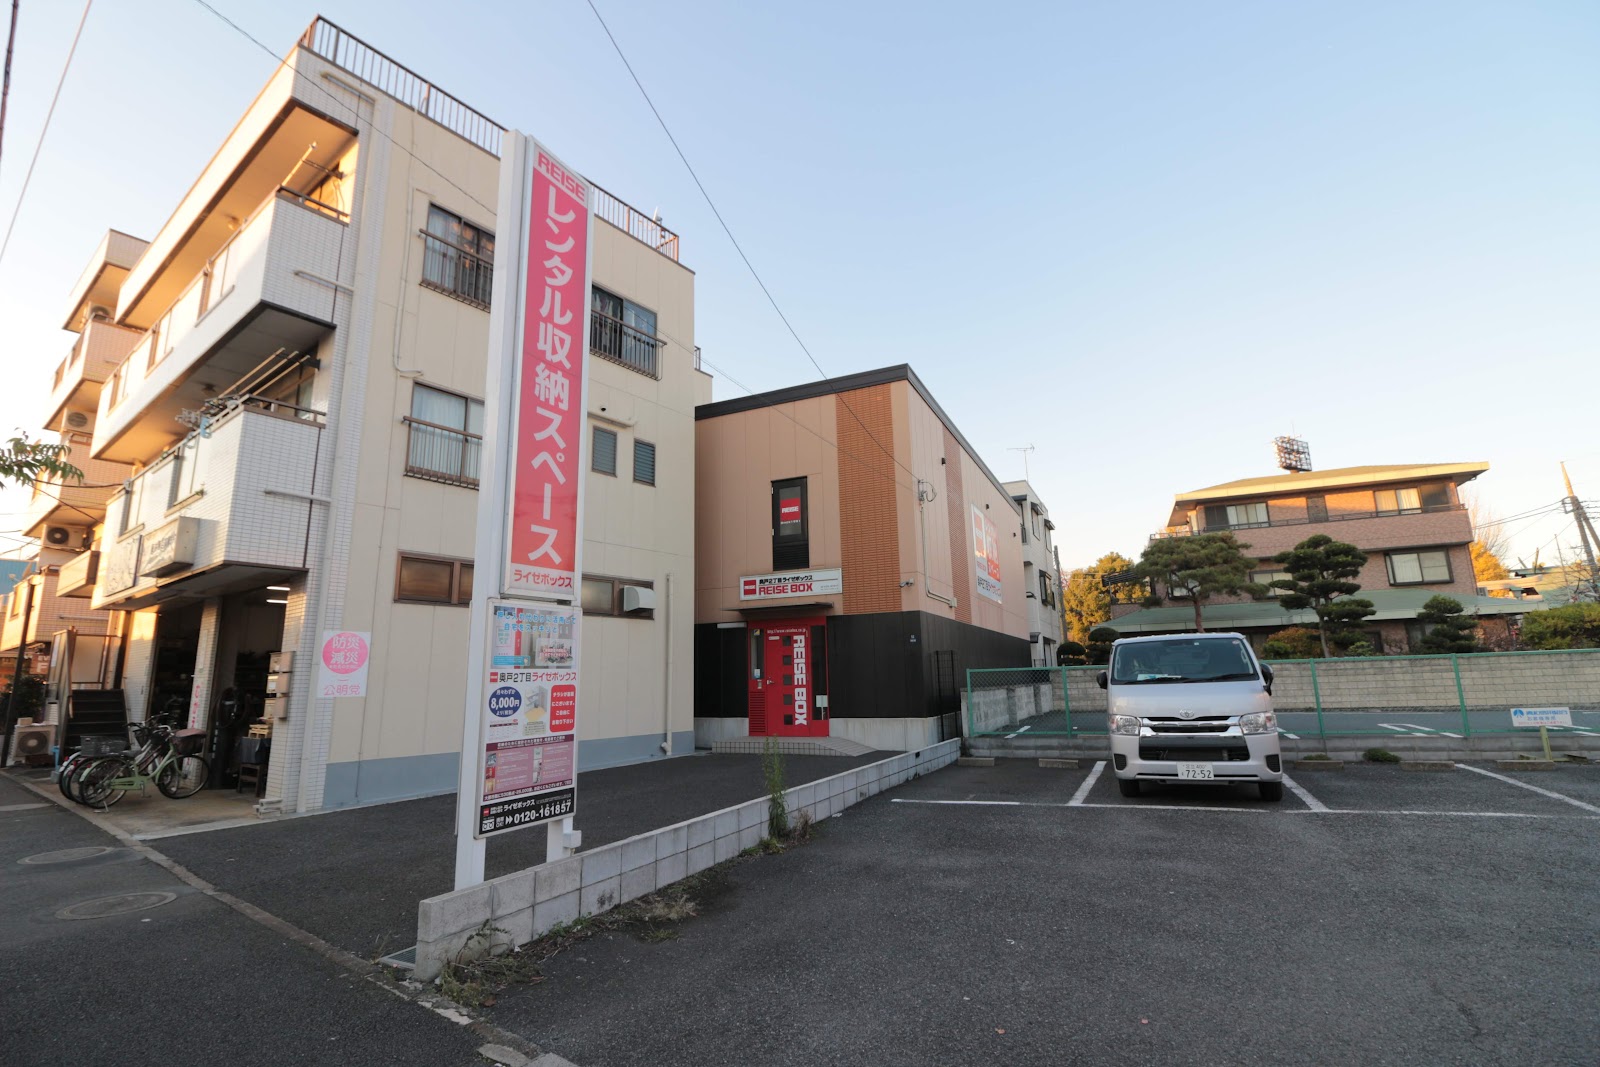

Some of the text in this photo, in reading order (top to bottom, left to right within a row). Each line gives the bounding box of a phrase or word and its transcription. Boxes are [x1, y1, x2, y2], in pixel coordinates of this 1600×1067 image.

[537, 151, 586, 203] REISE
[527, 184, 577, 566] レンタル収納スペース
[513, 569, 573, 588] ライゼボックス
[758, 584, 789, 596] REISE
[790, 582, 813, 593] BOX
[332, 636, 359, 649] 防災
[793, 634, 807, 726] REISE BOX
[323, 684, 361, 696] 公明党
[503, 799, 535, 812] ライゼボックス
[514, 802, 571, 824] 0120-161857
